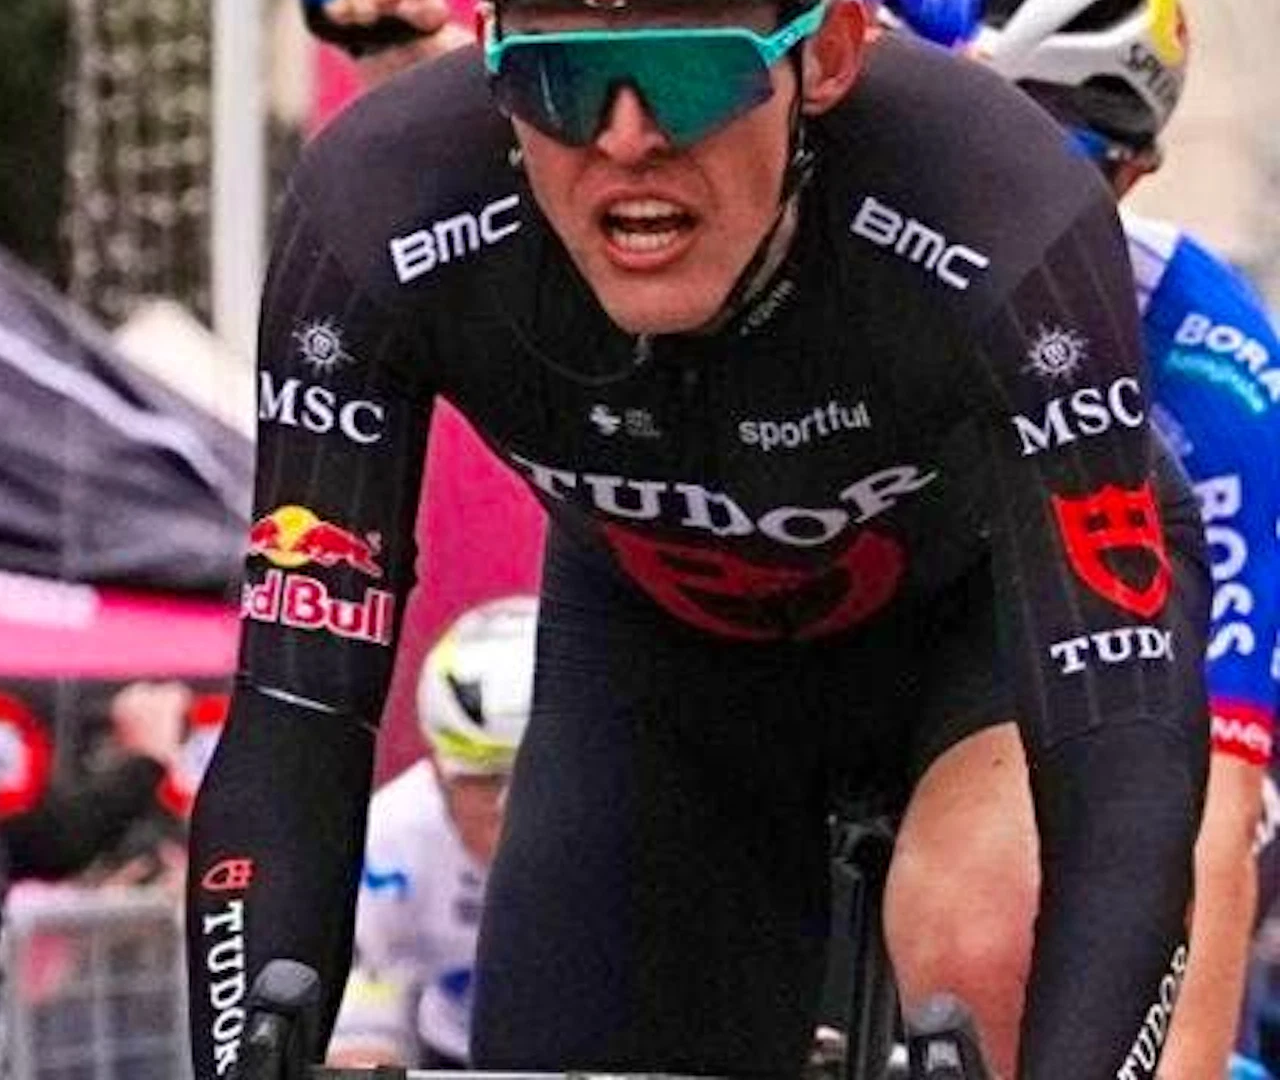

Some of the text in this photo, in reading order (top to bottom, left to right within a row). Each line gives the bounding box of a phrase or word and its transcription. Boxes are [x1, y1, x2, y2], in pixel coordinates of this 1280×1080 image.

[390, 194, 523, 284] BMC
[850, 196, 989, 291] BMC
[258, 369, 385, 444] MSC
[739, 400, 872, 452] sportful
[1013, 376, 1144, 456] MSC
[507, 451, 938, 547] TUDOR
[282, 573, 396, 647] Bull
[1050, 625, 1173, 674] TUD
[202, 898, 246, 1077] TUDOR
